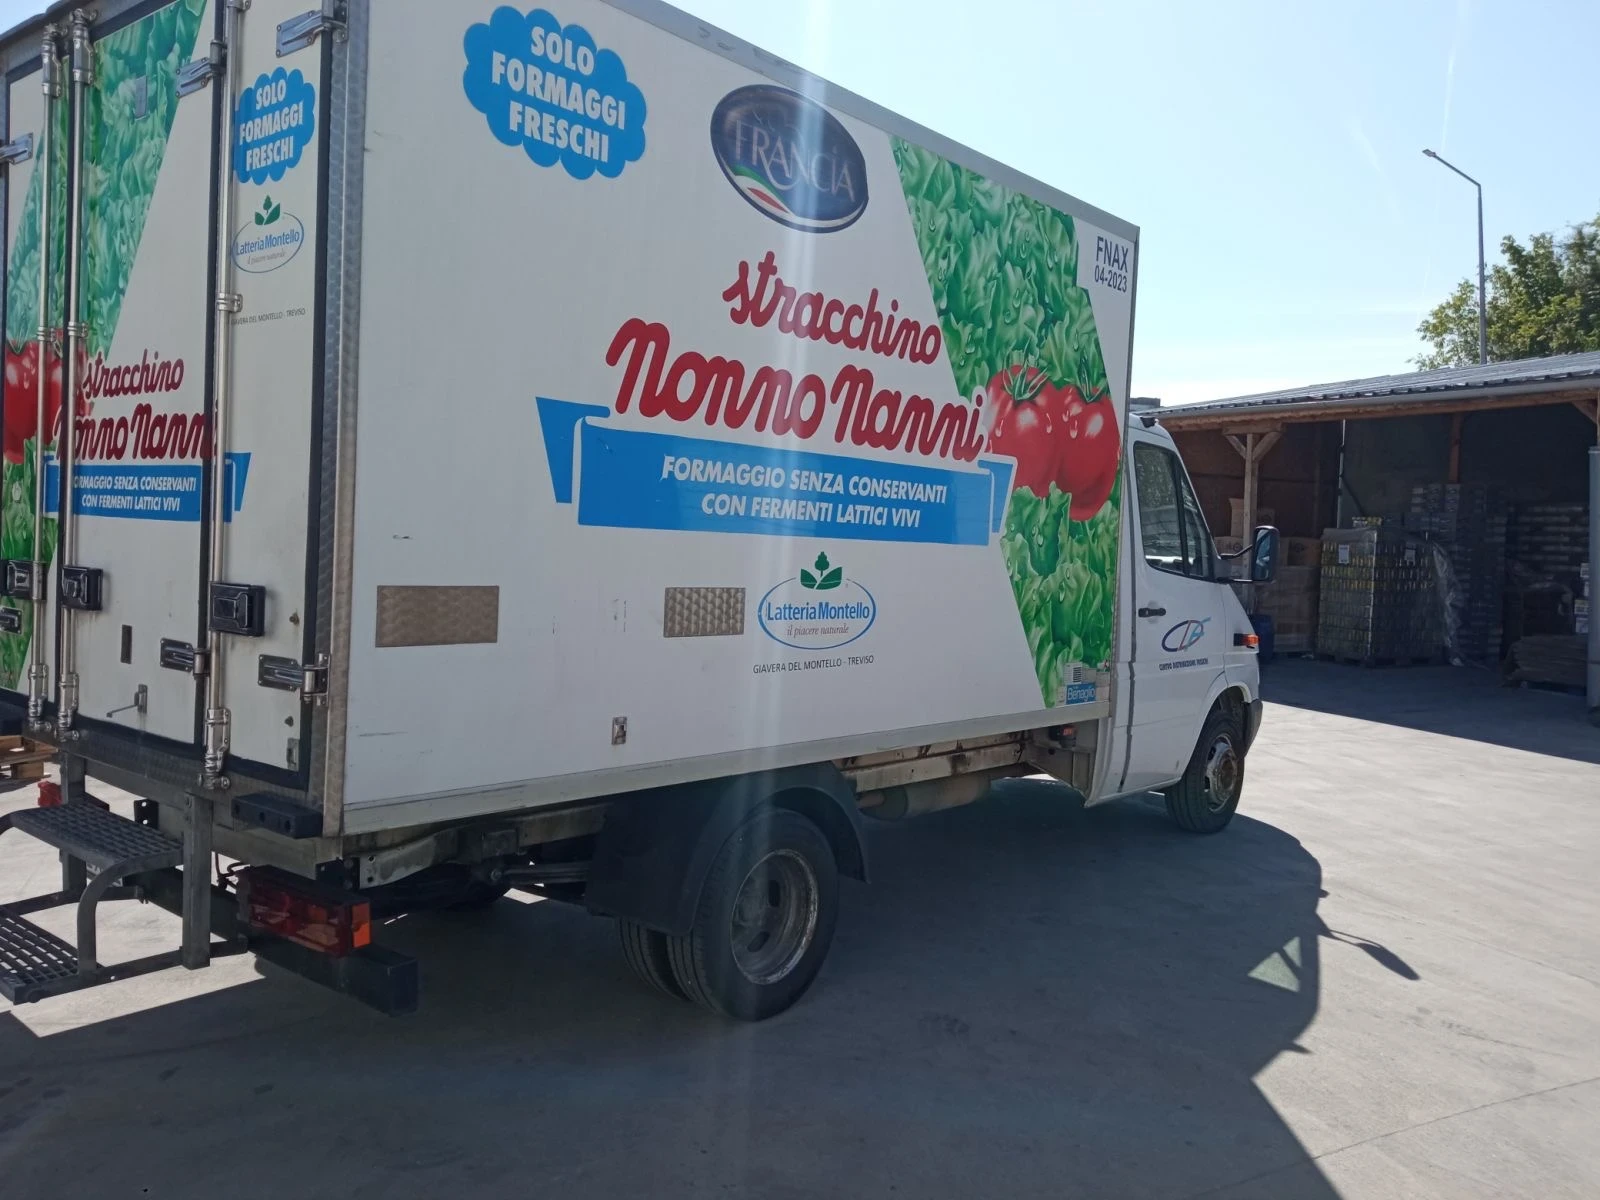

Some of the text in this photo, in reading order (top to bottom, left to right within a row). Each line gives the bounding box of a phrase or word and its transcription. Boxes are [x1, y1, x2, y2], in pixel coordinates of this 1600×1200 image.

[531, 26, 595, 75] SOLO
[256, 79, 287, 110] SOLO
[491, 50, 626, 130] FORMAGGI
[239, 101, 304, 145] FORMAGGI
[508, 100, 609, 163] FRESCHI
[245, 135, 294, 171] FRESCHI
[1096, 236, 1129, 273] FNAX
[1094, 265, 1128, 293] 04-2023
[722, 250, 942, 365] stracchino
[83, 348, 185, 400] stracchino
[605, 317, 985, 462] Nonno Nanni
[131, 403, 218, 460] Nann
[74, 475, 197, 492] ORMAGGIO SENZA CONSERVANTI
[660, 454, 948, 505] FORMAGGIO SENZA CONSERVANTI
[81, 494, 181, 512] CON FERMENTI LATTICI VIVI
[701, 493, 921, 528] CON FERMENTI LATTICI VIVI
[753, 662, 787, 674] GIAVERA
[788, 661, 802, 672] DEL
[803, 657, 842, 670] MONTELLO
[848, 654, 875, 666] TREVISO
